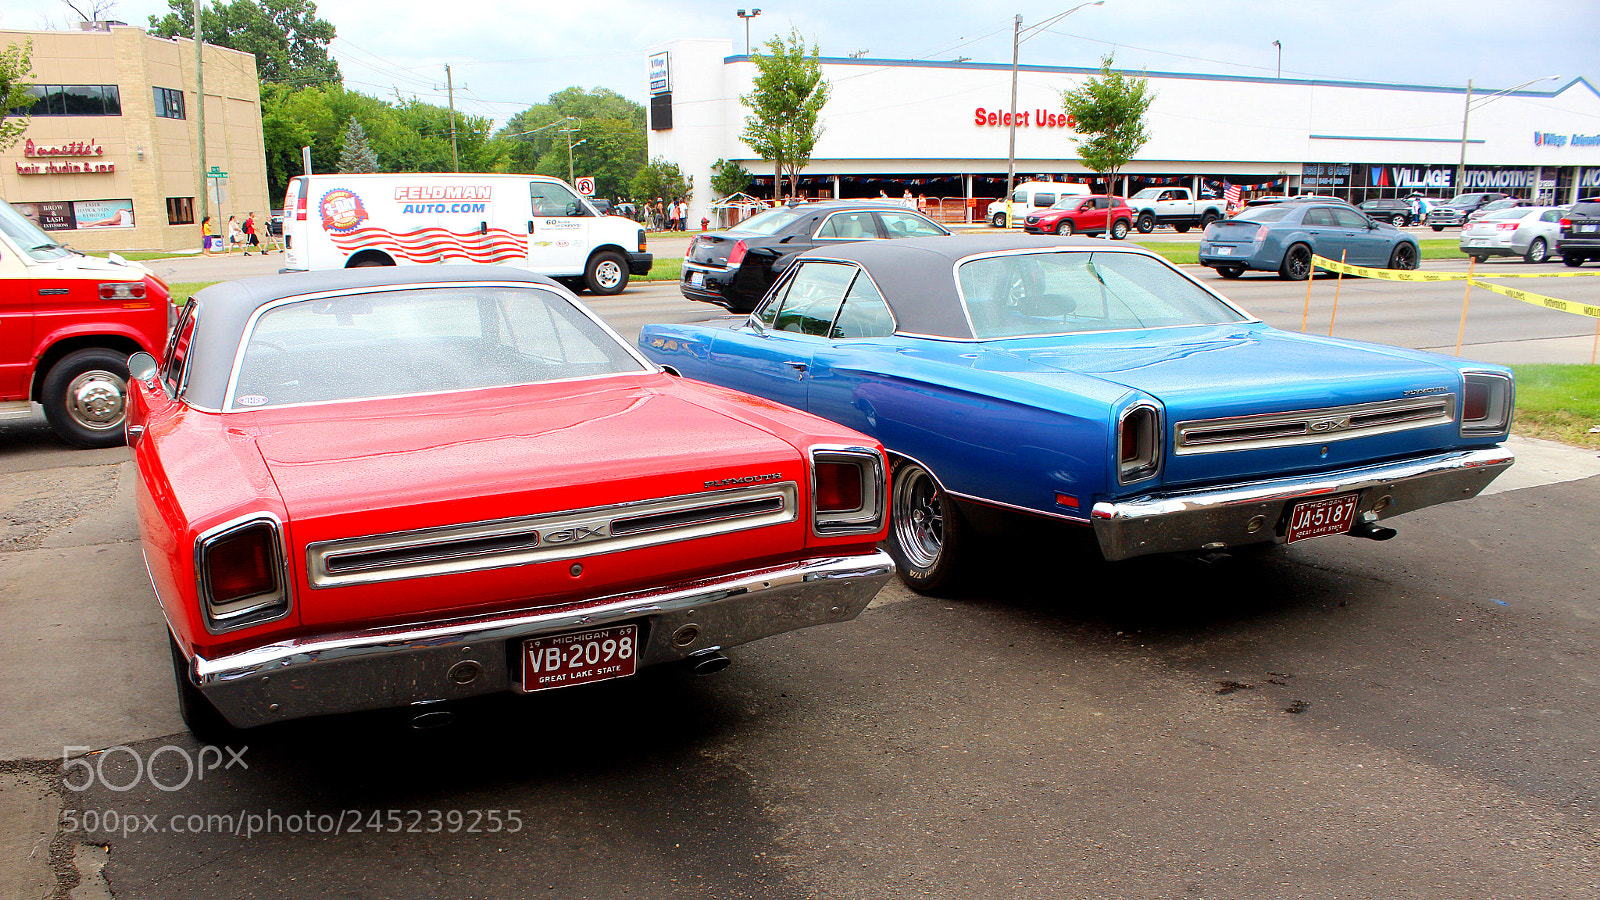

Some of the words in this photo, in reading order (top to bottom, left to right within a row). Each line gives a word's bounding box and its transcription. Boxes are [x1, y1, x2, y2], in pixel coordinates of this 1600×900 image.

[975, 108, 1030, 126] Select
[24, 138, 103, 157] Annette's
[16, 162, 40, 174] hair
[45, 161, 80, 174] studio
[84, 162, 92, 172] &
[95, 164, 114, 175] spa
[1303, 166, 1324, 175] USED
[1392, 168, 1451, 187] VILLAGE
[1457, 170, 1535, 188] UTOMOTIVE
[394, 186, 492, 200] FELDMAN
[403, 204, 486, 214] AUTO.COM
[704, 473, 782, 488] PLYMOUTH
[1310, 499, 1342, 508] MICHIGAN
[542, 525, 605, 543] GTX
[530, 641, 540, 649] 19
[553, 631, 609, 644] MICHIGAN
[539, 674, 567, 683] GREAT
[571, 670, 593, 679] LAKE
[597, 665, 621, 674] STATE
